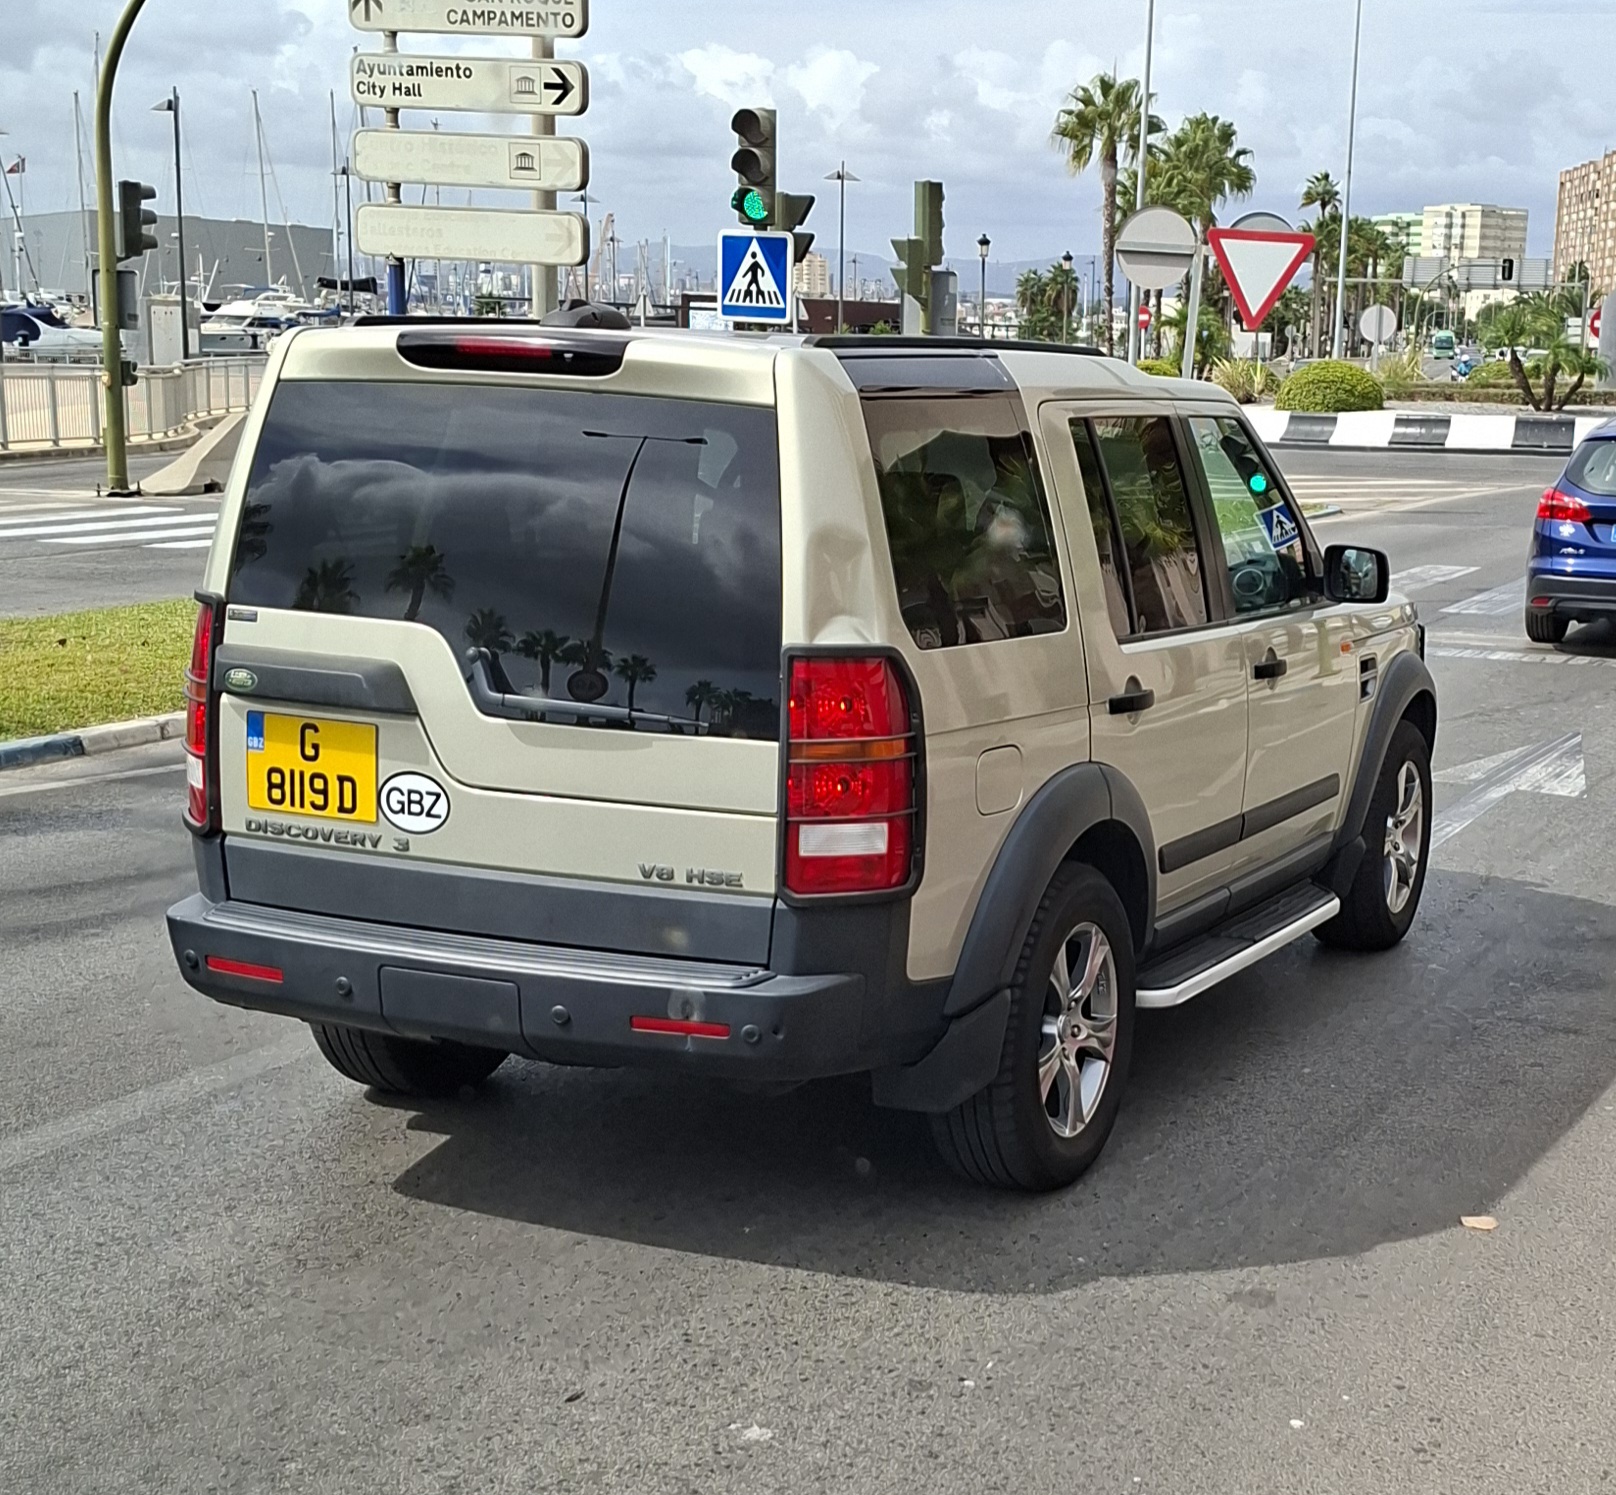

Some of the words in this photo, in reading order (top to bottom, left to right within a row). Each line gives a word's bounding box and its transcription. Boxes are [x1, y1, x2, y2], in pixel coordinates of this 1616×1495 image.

[446, 9, 575, 28] CAMPAMENTO
[356, 58, 473, 79] Ayuntamiento
[356, 81, 386, 98] City
[392, 82, 422, 97] Hall
[247, 736, 264, 749] GBZ
[300, 722, 320, 762] G
[385, 786, 442, 819] GBZ
[246, 817, 382, 849] DISCOVERY
[393, 837, 410, 852] 3
[638, 863, 674, 881] V8
[686, 868, 743, 887] HSE
